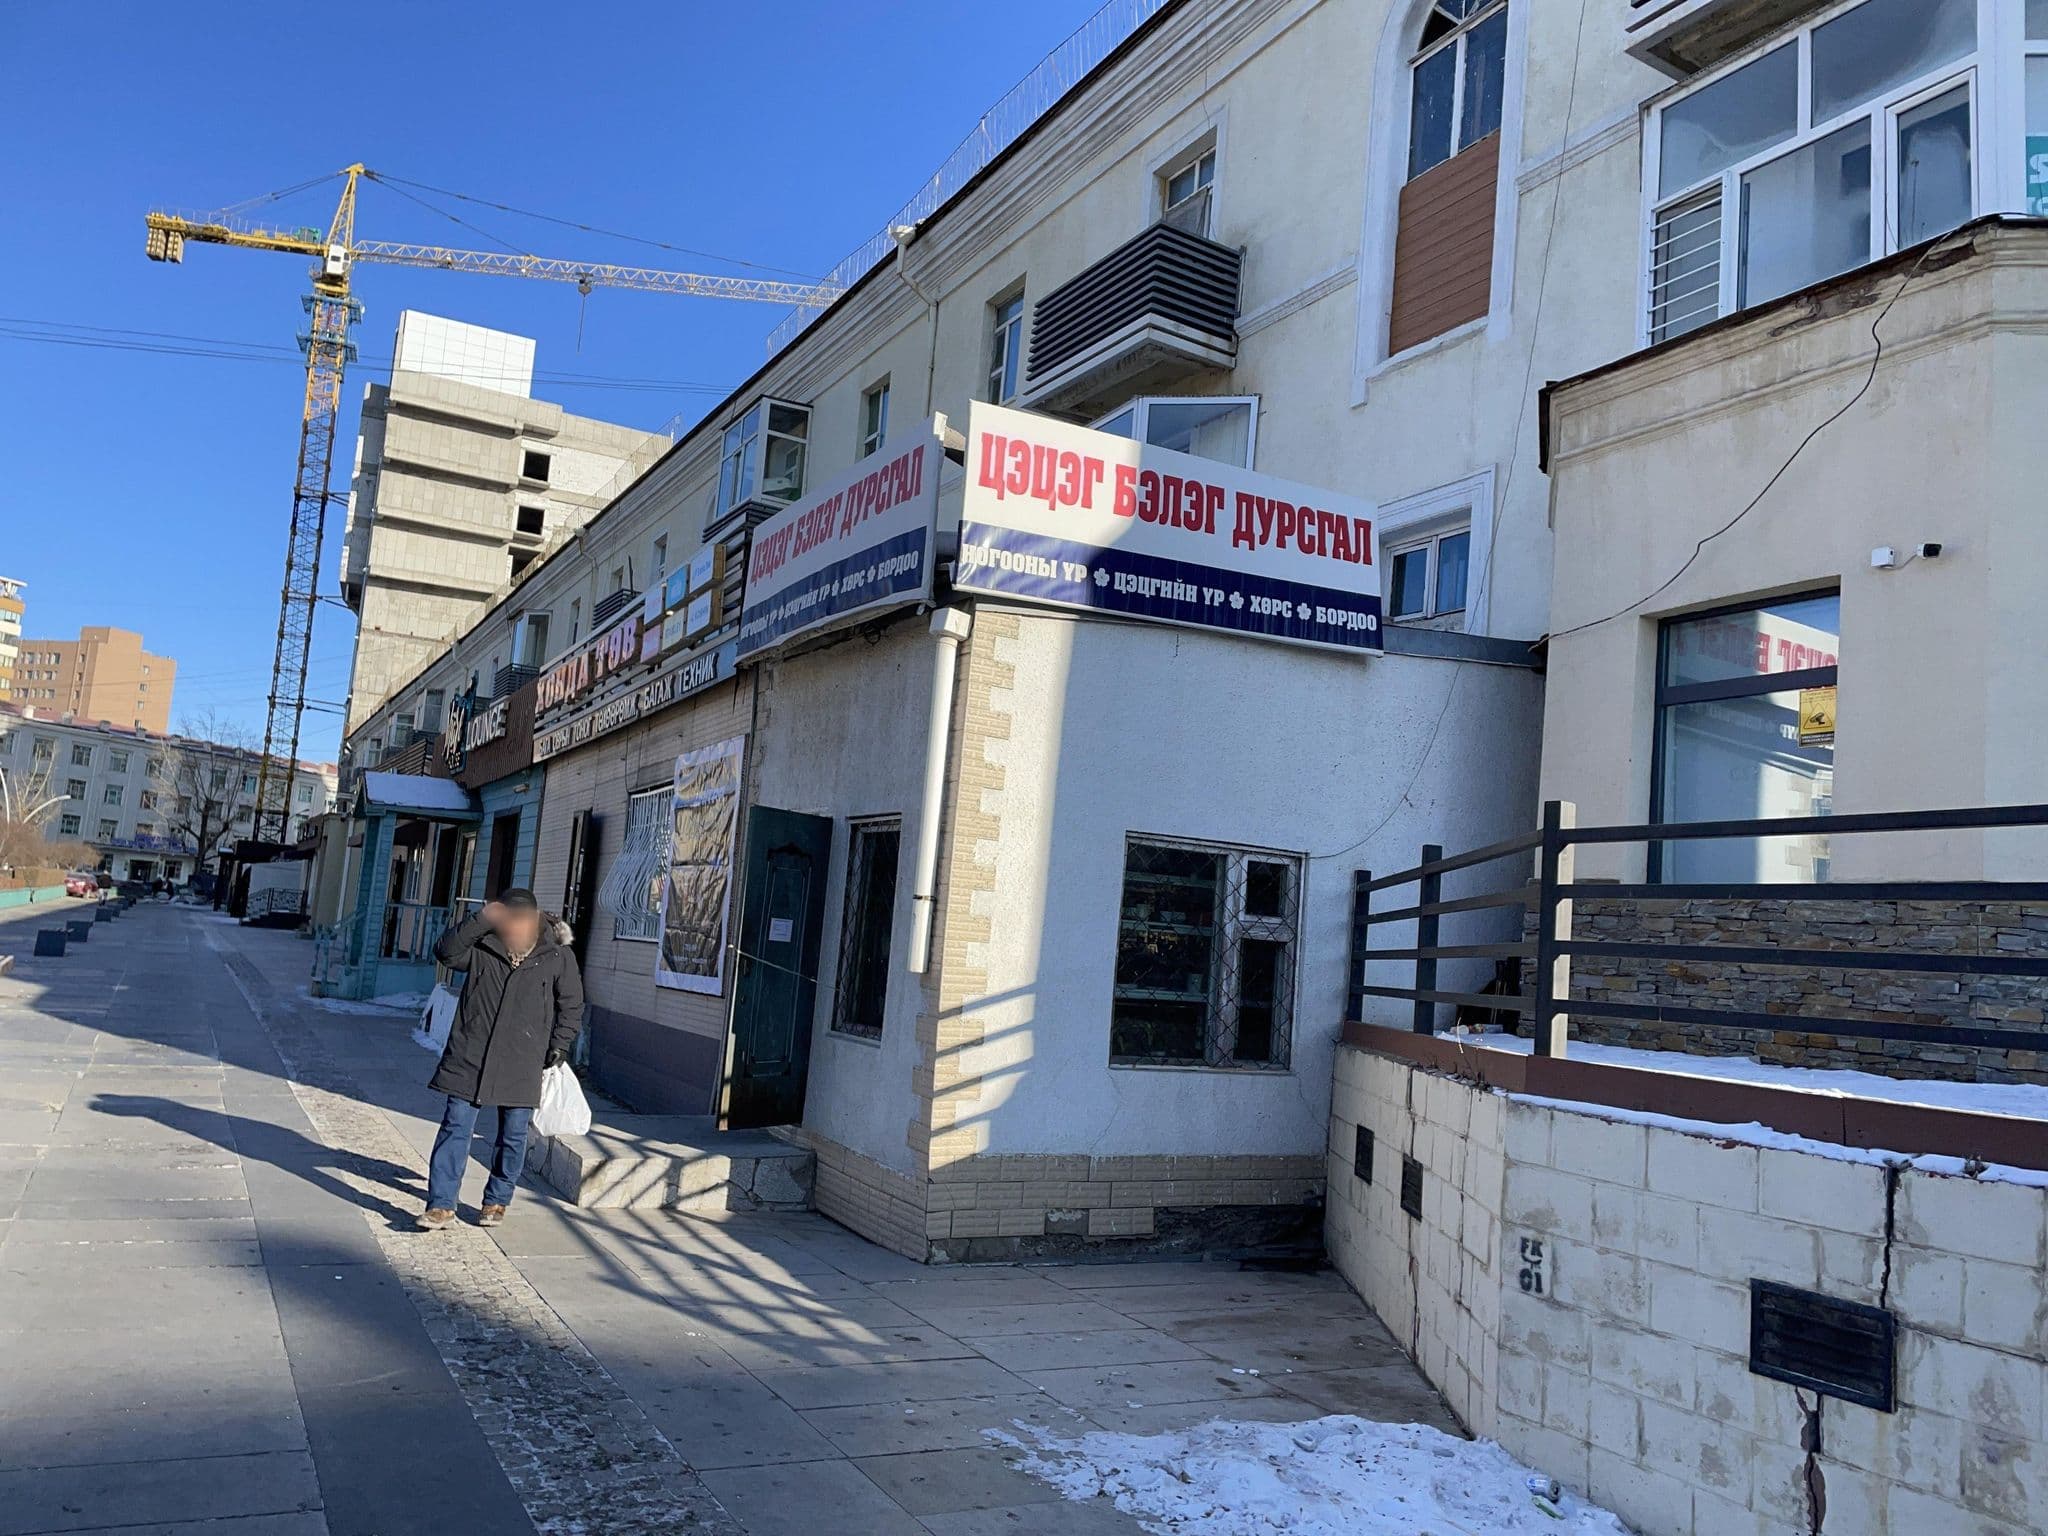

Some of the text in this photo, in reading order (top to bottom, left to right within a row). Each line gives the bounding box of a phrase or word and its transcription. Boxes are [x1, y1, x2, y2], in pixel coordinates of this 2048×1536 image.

[751, 444, 925, 587] ЦЭЦЭГ БЭЛЭГ ДУРСГАЛ
[979, 431, 1373, 566] ЦЭЦЭГ БЭЛЭГ ДУРСГАЛ
[877, 551, 919, 580] БОРДОО
[960, 543, 1057, 579] НОГООНЫ
[1114, 571, 1198, 603] ЦЭЦГИЙН
[1250, 596, 1292, 618] ХӨРС
[1316, 606, 1377, 631] БОРДОО
[643, 674, 673, 710] БАГАЖ
[678, 652, 716, 693] ТЕХНИК
[465, 701, 510, 752] LOUNGE
